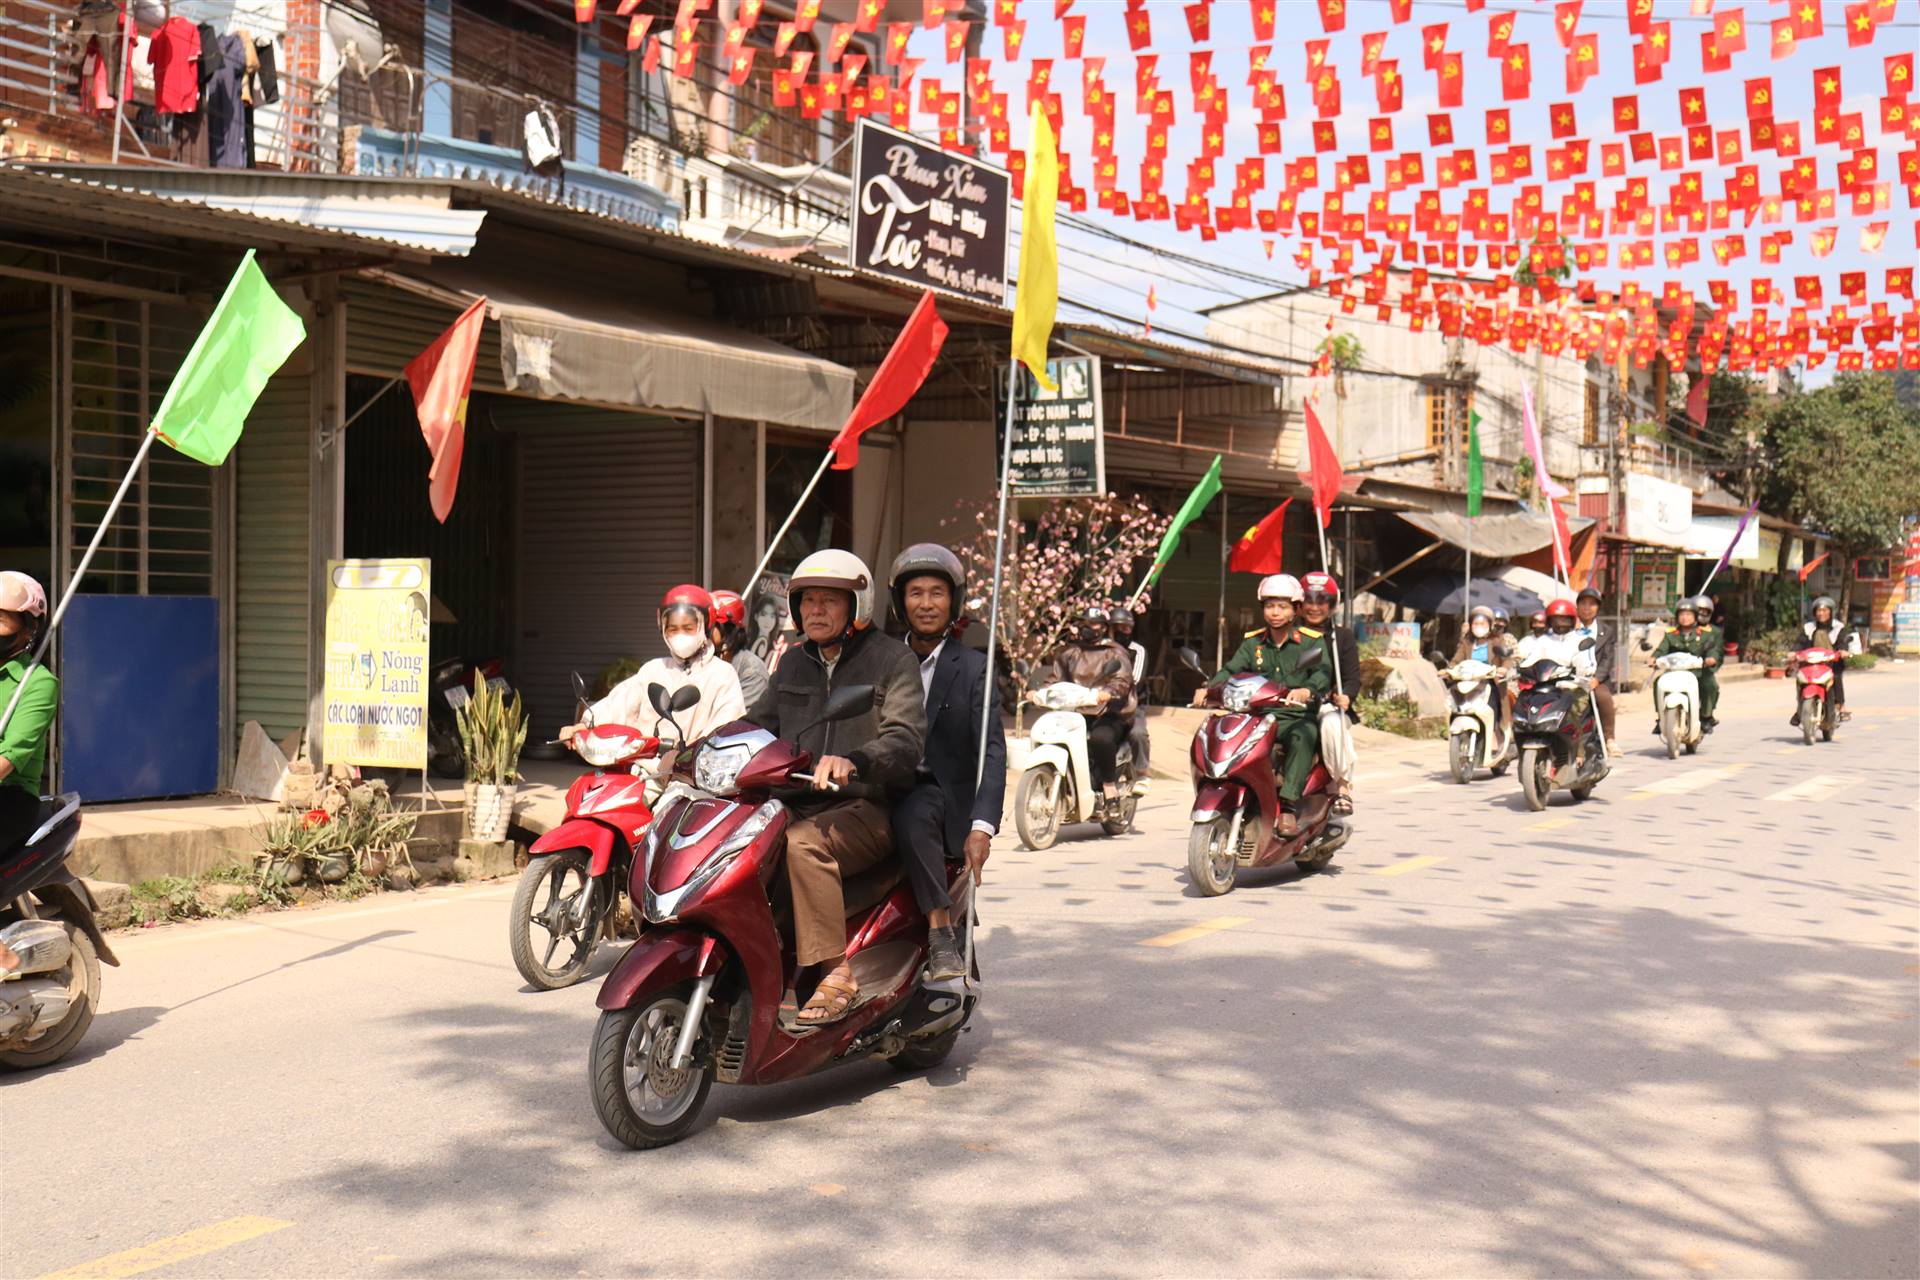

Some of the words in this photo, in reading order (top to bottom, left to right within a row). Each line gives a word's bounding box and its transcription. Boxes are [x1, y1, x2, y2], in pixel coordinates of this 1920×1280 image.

[861, 173, 930, 270] Tóc
[1026, 403, 1045, 421] TÓC
[1046, 405, 1070, 420] NAM
[382, 650, 424, 675] Nóng
[381, 674, 420, 698] Lạnh
[327, 698, 344, 723] CÁC
[345, 703, 366, 730] LOẠI
[368, 700, 394, 725] NƯỚC
[396, 706, 423, 733] NGỌT
